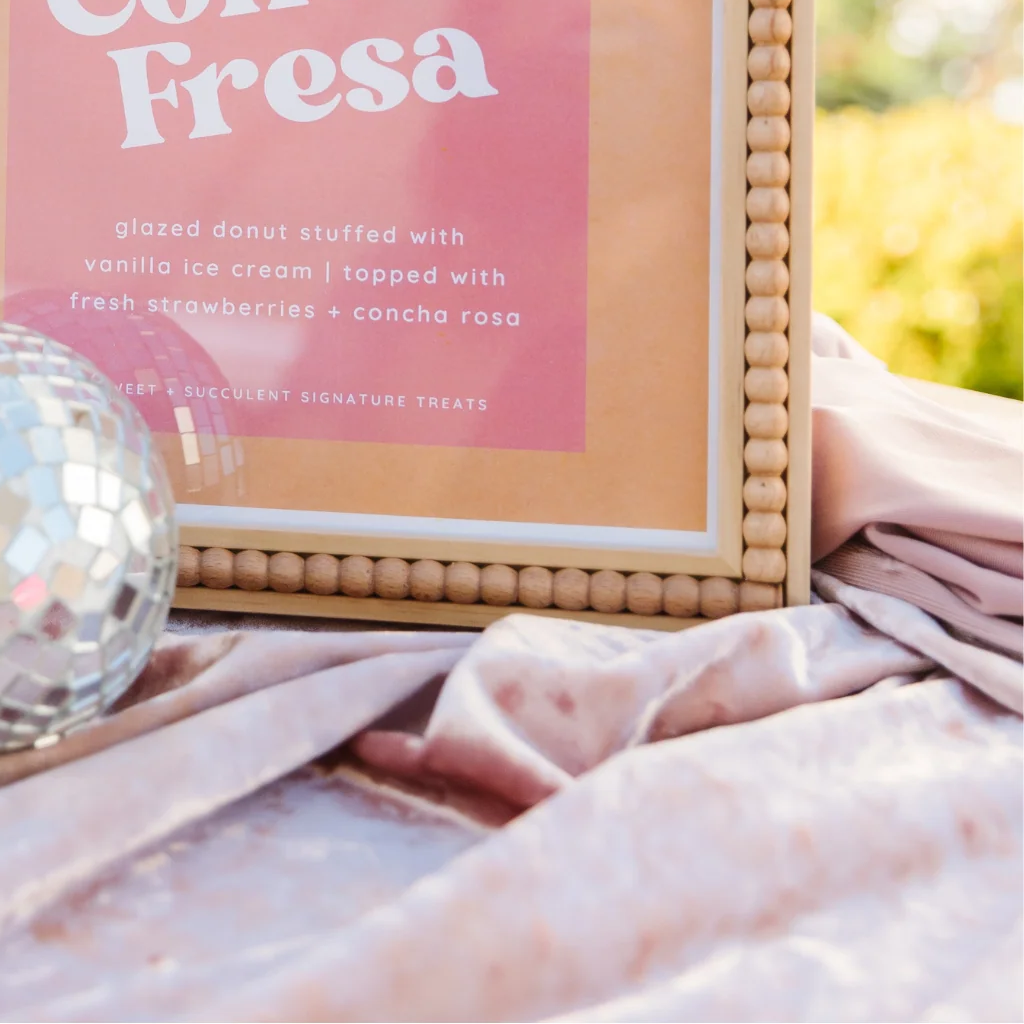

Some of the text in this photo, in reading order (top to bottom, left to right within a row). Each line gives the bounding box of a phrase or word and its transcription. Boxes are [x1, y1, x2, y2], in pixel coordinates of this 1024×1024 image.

[107, 27, 498, 149] Fresa
[115, 217, 464, 246] glazed donut stuffed with
[85, 256, 171, 275] vanilla
[184, 258, 219, 276] ice
[231, 263, 312, 280] cream
[343, 265, 437, 287] topped
[451, 267, 506, 287] with
[70, 291, 520, 327] fresh strawberries + concha rosa
[115, 382, 156, 396] EET
[184, 385, 291, 402] SUCCULENT
[300, 391, 406, 408] SIGNATURE
[416, 395, 487, 412] TREATS
